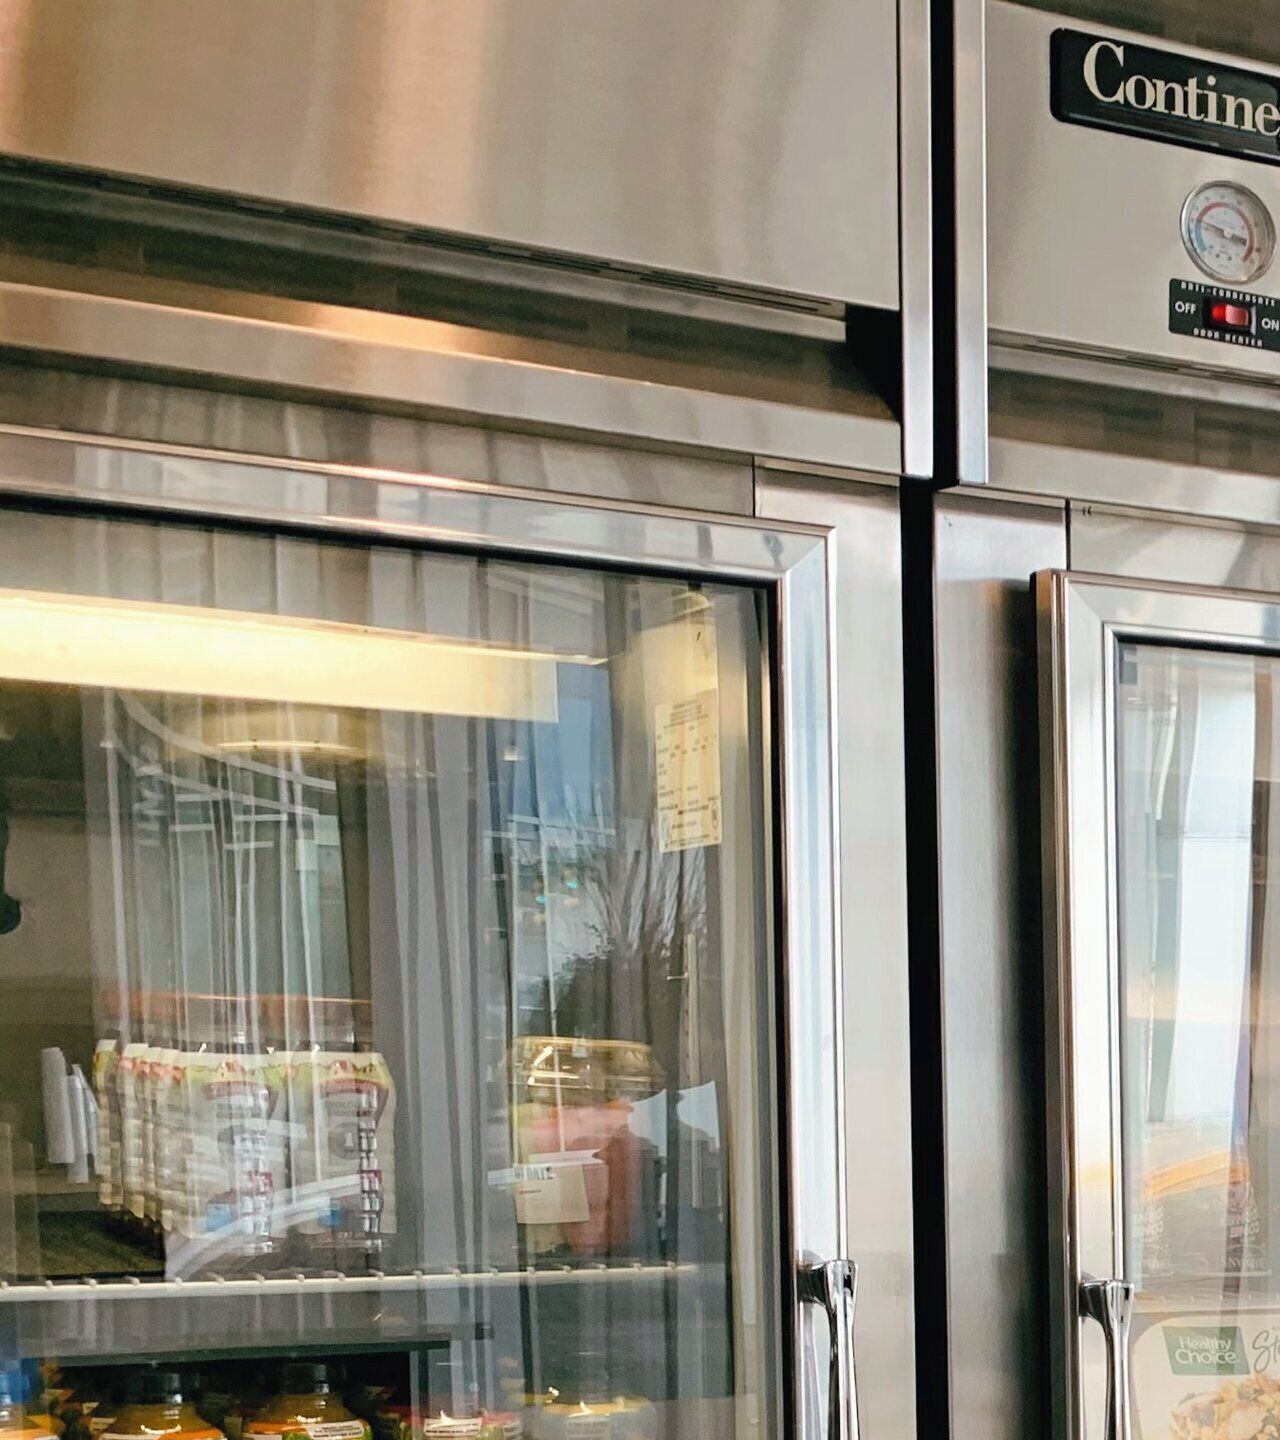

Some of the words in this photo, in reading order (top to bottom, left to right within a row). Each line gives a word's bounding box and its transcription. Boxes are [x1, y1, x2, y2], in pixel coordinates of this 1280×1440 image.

[1181, 281, 1275, 307] ANTI-CONDENSATE
[1174, 301, 1197, 314] OFF
[1261, 318, 1279, 331] ON
[1193, 328, 1219, 338] DOOR
[1225, 333, 1263, 347] HEATER
[1179, 1336, 1231, 1352] Healthy
[1176, 1349, 1236, 1364] Choice
